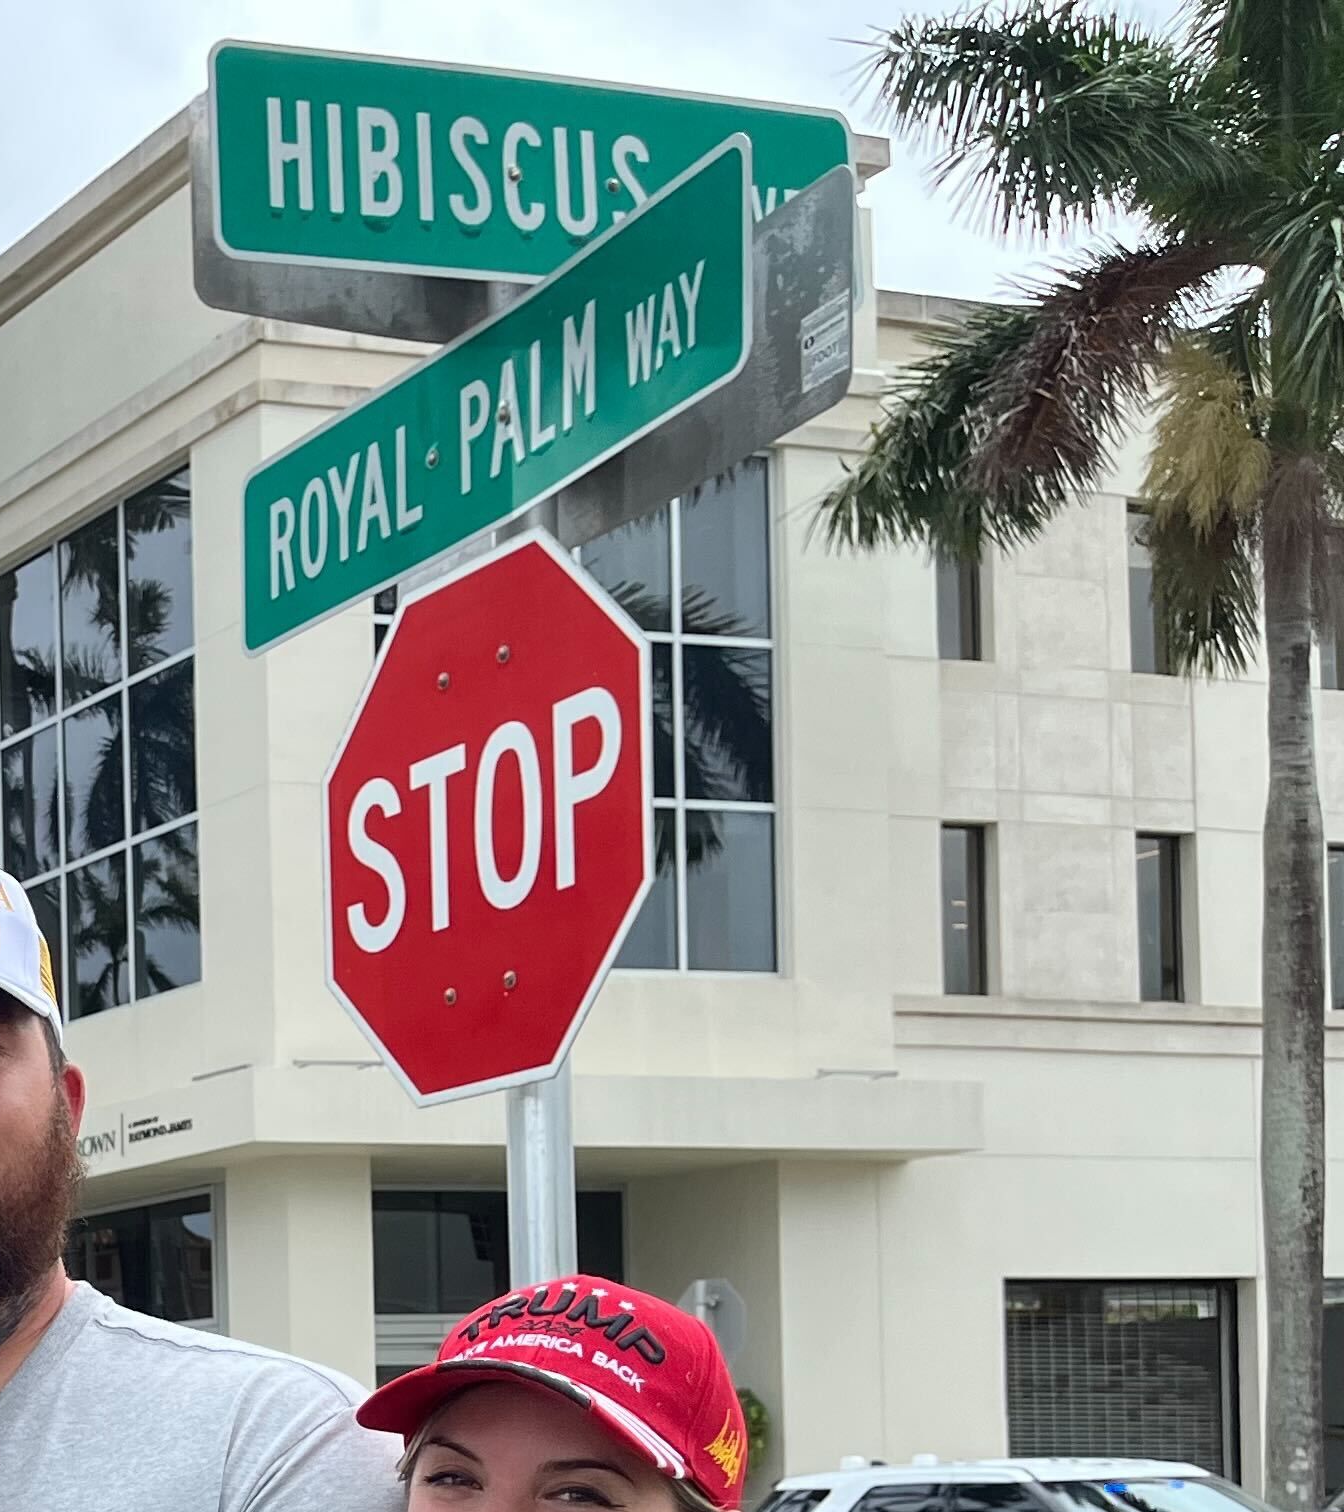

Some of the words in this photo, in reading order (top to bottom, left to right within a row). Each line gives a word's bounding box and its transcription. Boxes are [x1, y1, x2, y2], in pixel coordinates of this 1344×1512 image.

[265, 97, 650, 237] HIBISCUS
[269, 426, 423, 600] ROYAL
[459, 299, 596, 495] PALM
[624, 258, 706, 386] WAY
[346, 686, 623, 954] STOP
[451, 1341, 489, 1361] AKE
[490, 1333, 584, 1358] AMERICA
[592, 1350, 646, 1394] BACK
[458, 1288, 666, 1365] TRUMP
